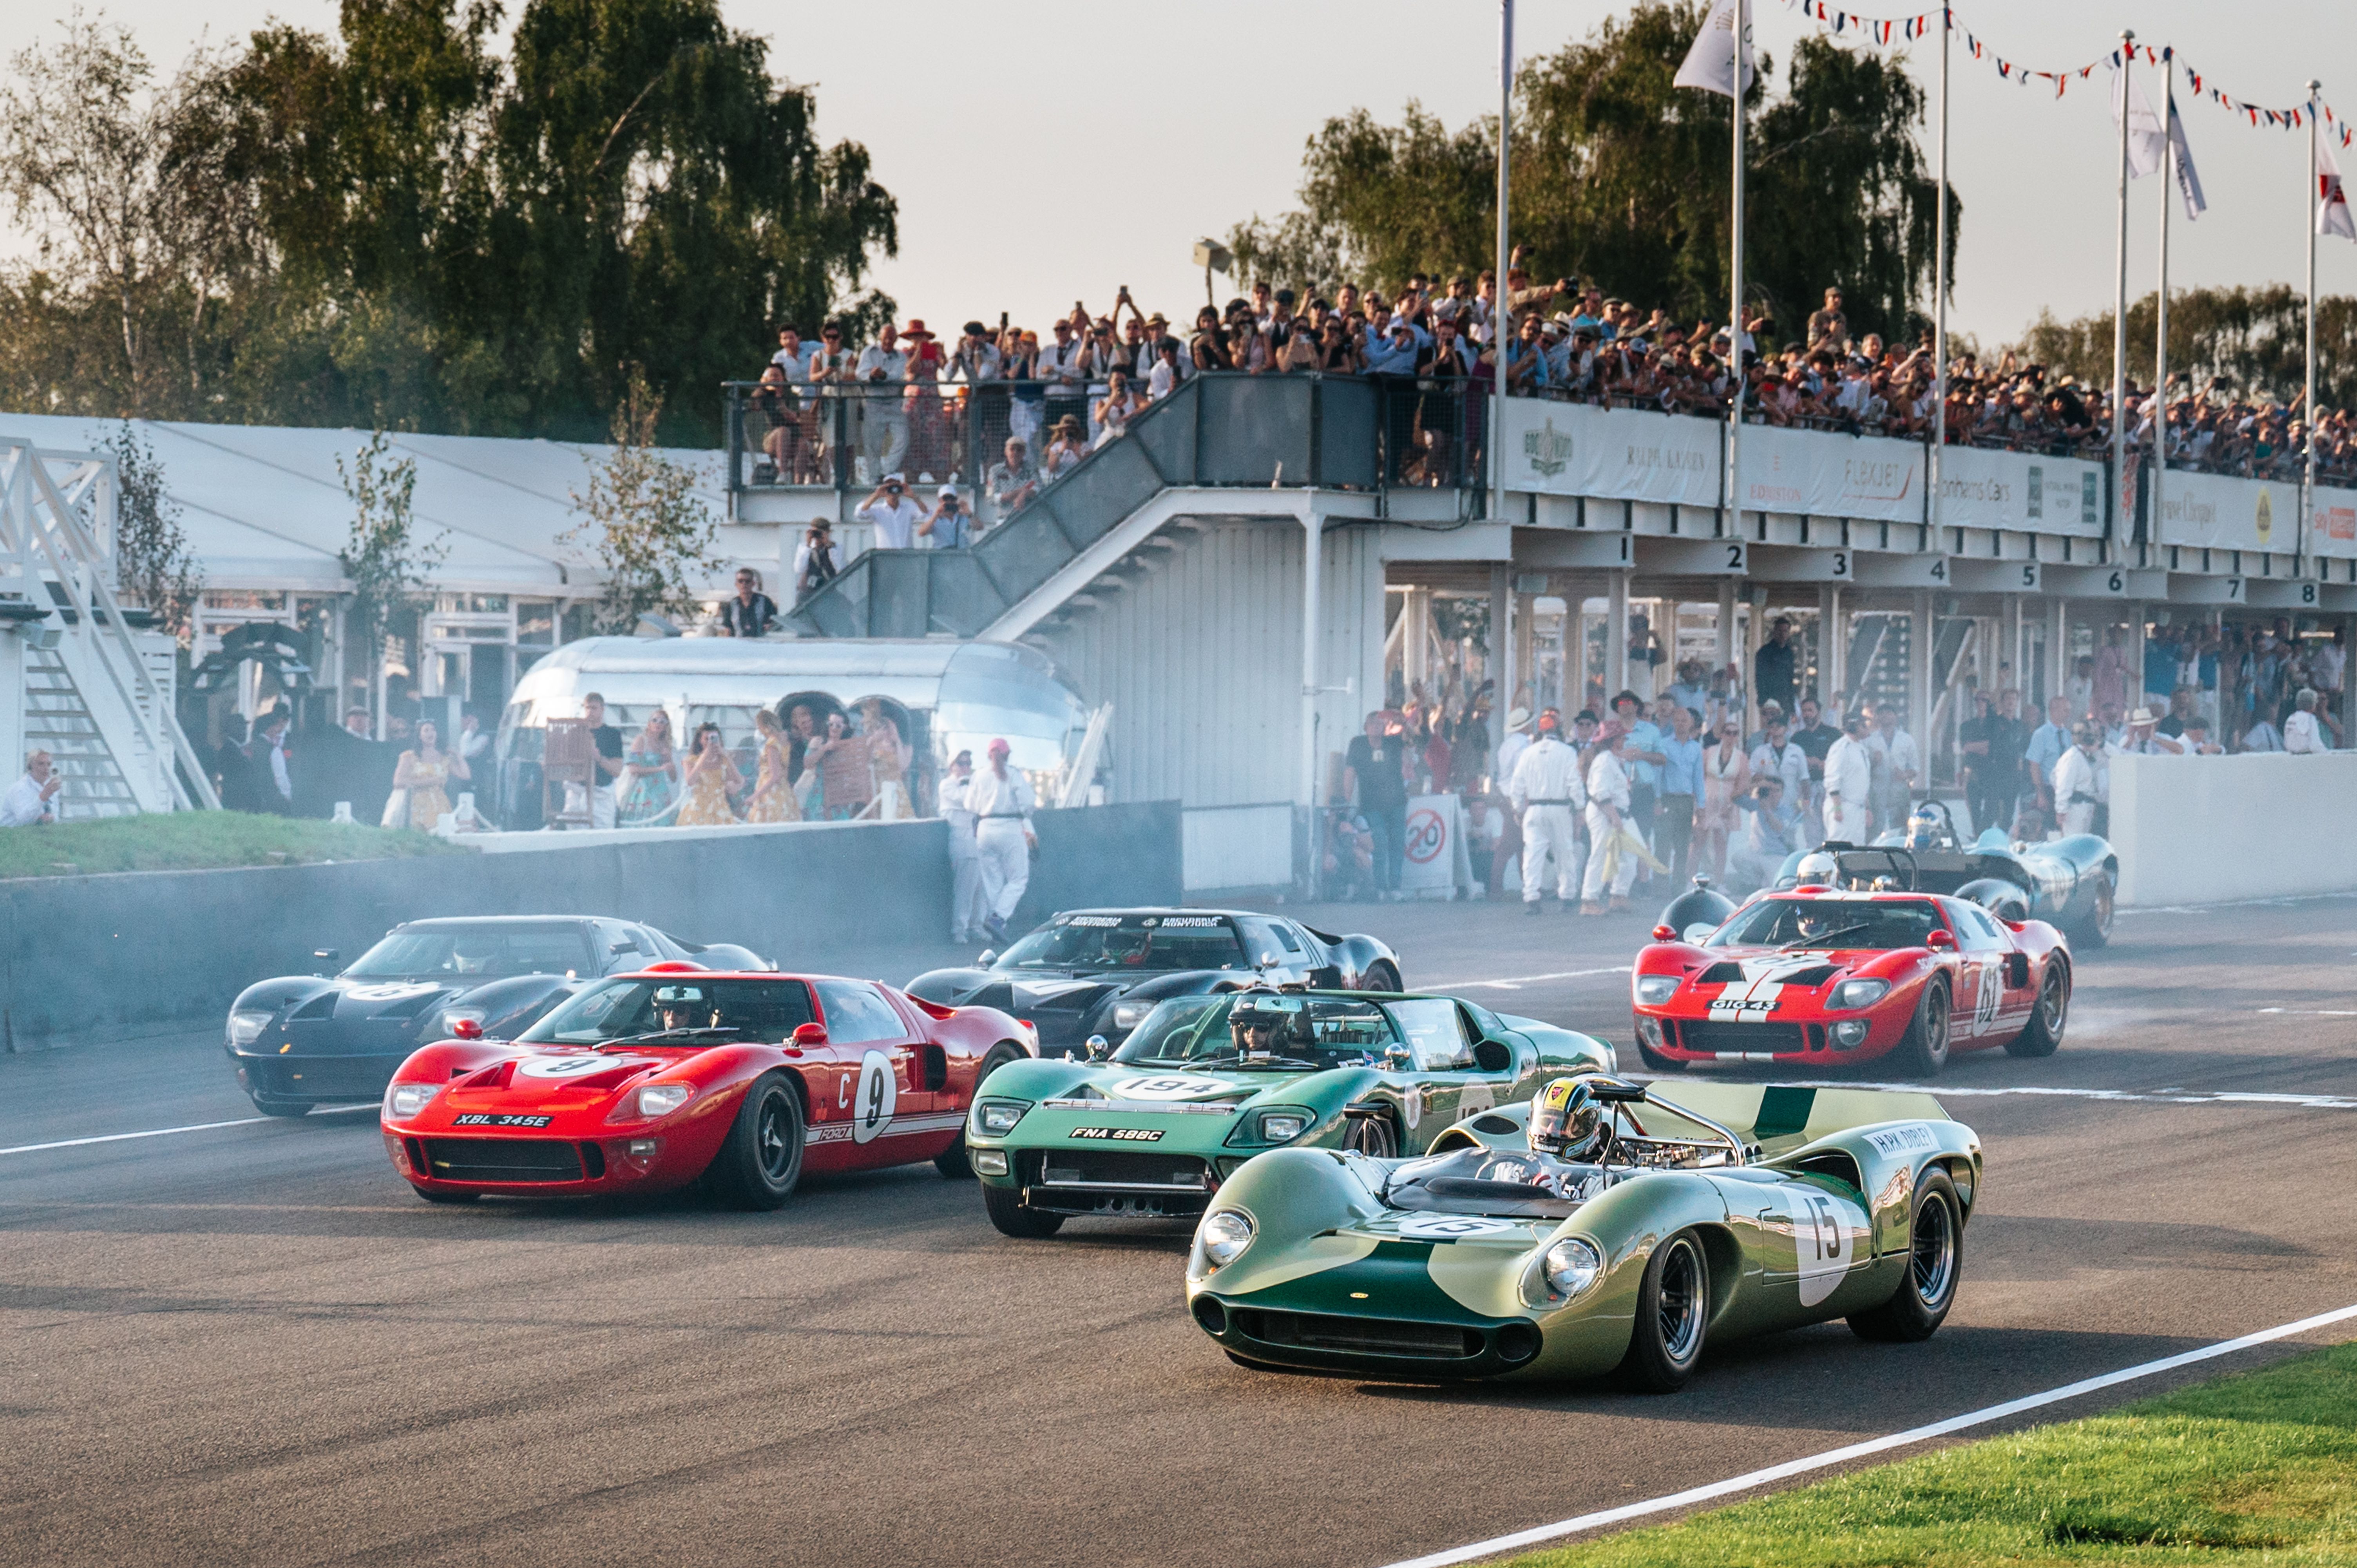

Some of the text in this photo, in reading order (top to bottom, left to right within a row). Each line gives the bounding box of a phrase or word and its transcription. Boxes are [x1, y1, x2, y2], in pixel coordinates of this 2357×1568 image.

[1622, 537, 1627, 561] 1
[1727, 545, 1742, 568] 2
[1833, 553, 1847, 575] 3
[1930, 560, 1944, 580] 4
[2022, 566, 2035, 586] 5
[2108, 571, 2122, 591] 6
[2227, 579, 2240, 599] 7
[2302, 584, 2315, 602] 8
[1711, 1000, 1776, 1011] GIG 43
[546, 1059, 598, 1072] 9
[838, 1072, 851, 1109] C
[1124, 1079, 1218, 1093] 194
[866, 1067, 884, 1129] 9
[456, 1114, 550, 1127] XBL 345E
[820, 1127, 846, 1140] FORD
[1071, 1128, 1164, 1140] FNA 588C
[1900, 1127, 1933, 1148] DIBLEY
[1414, 1219, 1503, 1233] 15
[1803, 1197, 1841, 1261] 15
